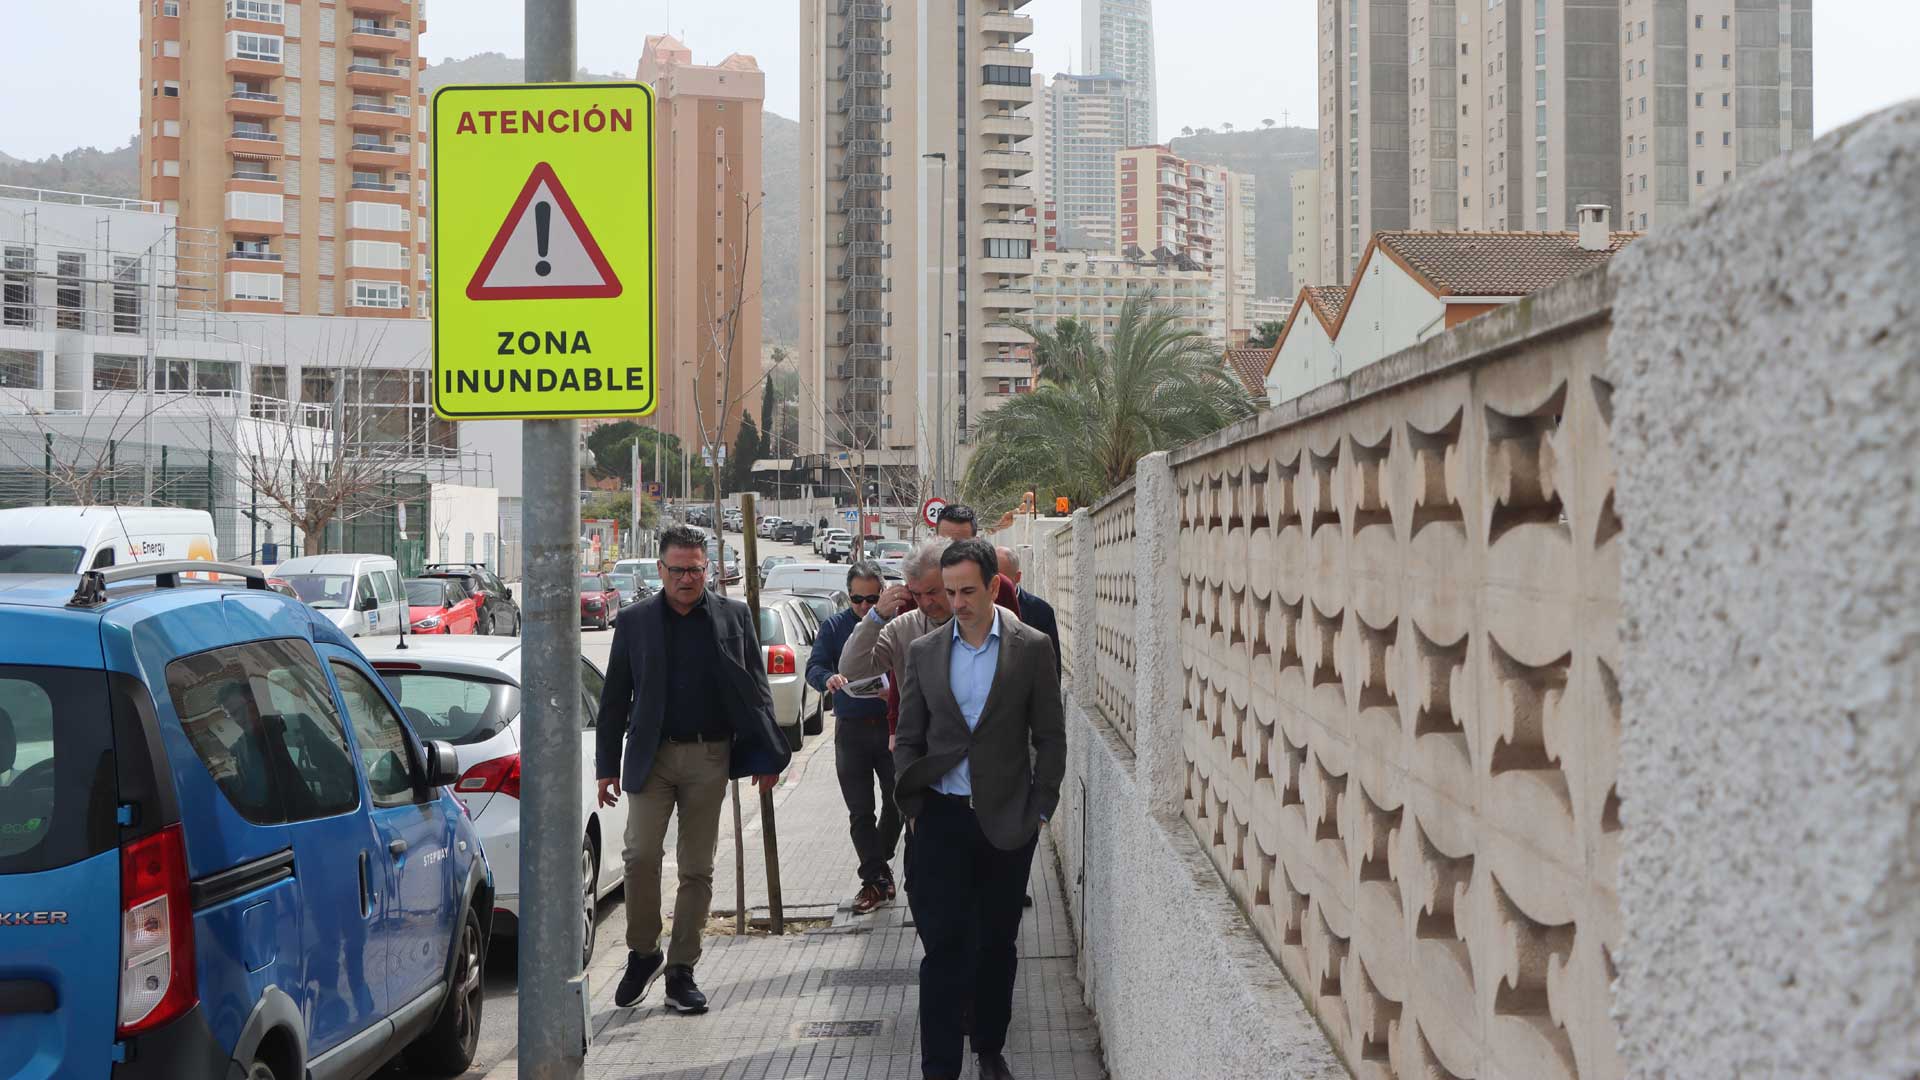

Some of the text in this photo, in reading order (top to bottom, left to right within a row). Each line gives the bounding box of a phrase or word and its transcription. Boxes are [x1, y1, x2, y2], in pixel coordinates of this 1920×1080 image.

[457, 104, 633, 134] ATENCIÓN
[497, 331, 592, 355] ZONA
[445, 367, 645, 393] INUNDABLE
